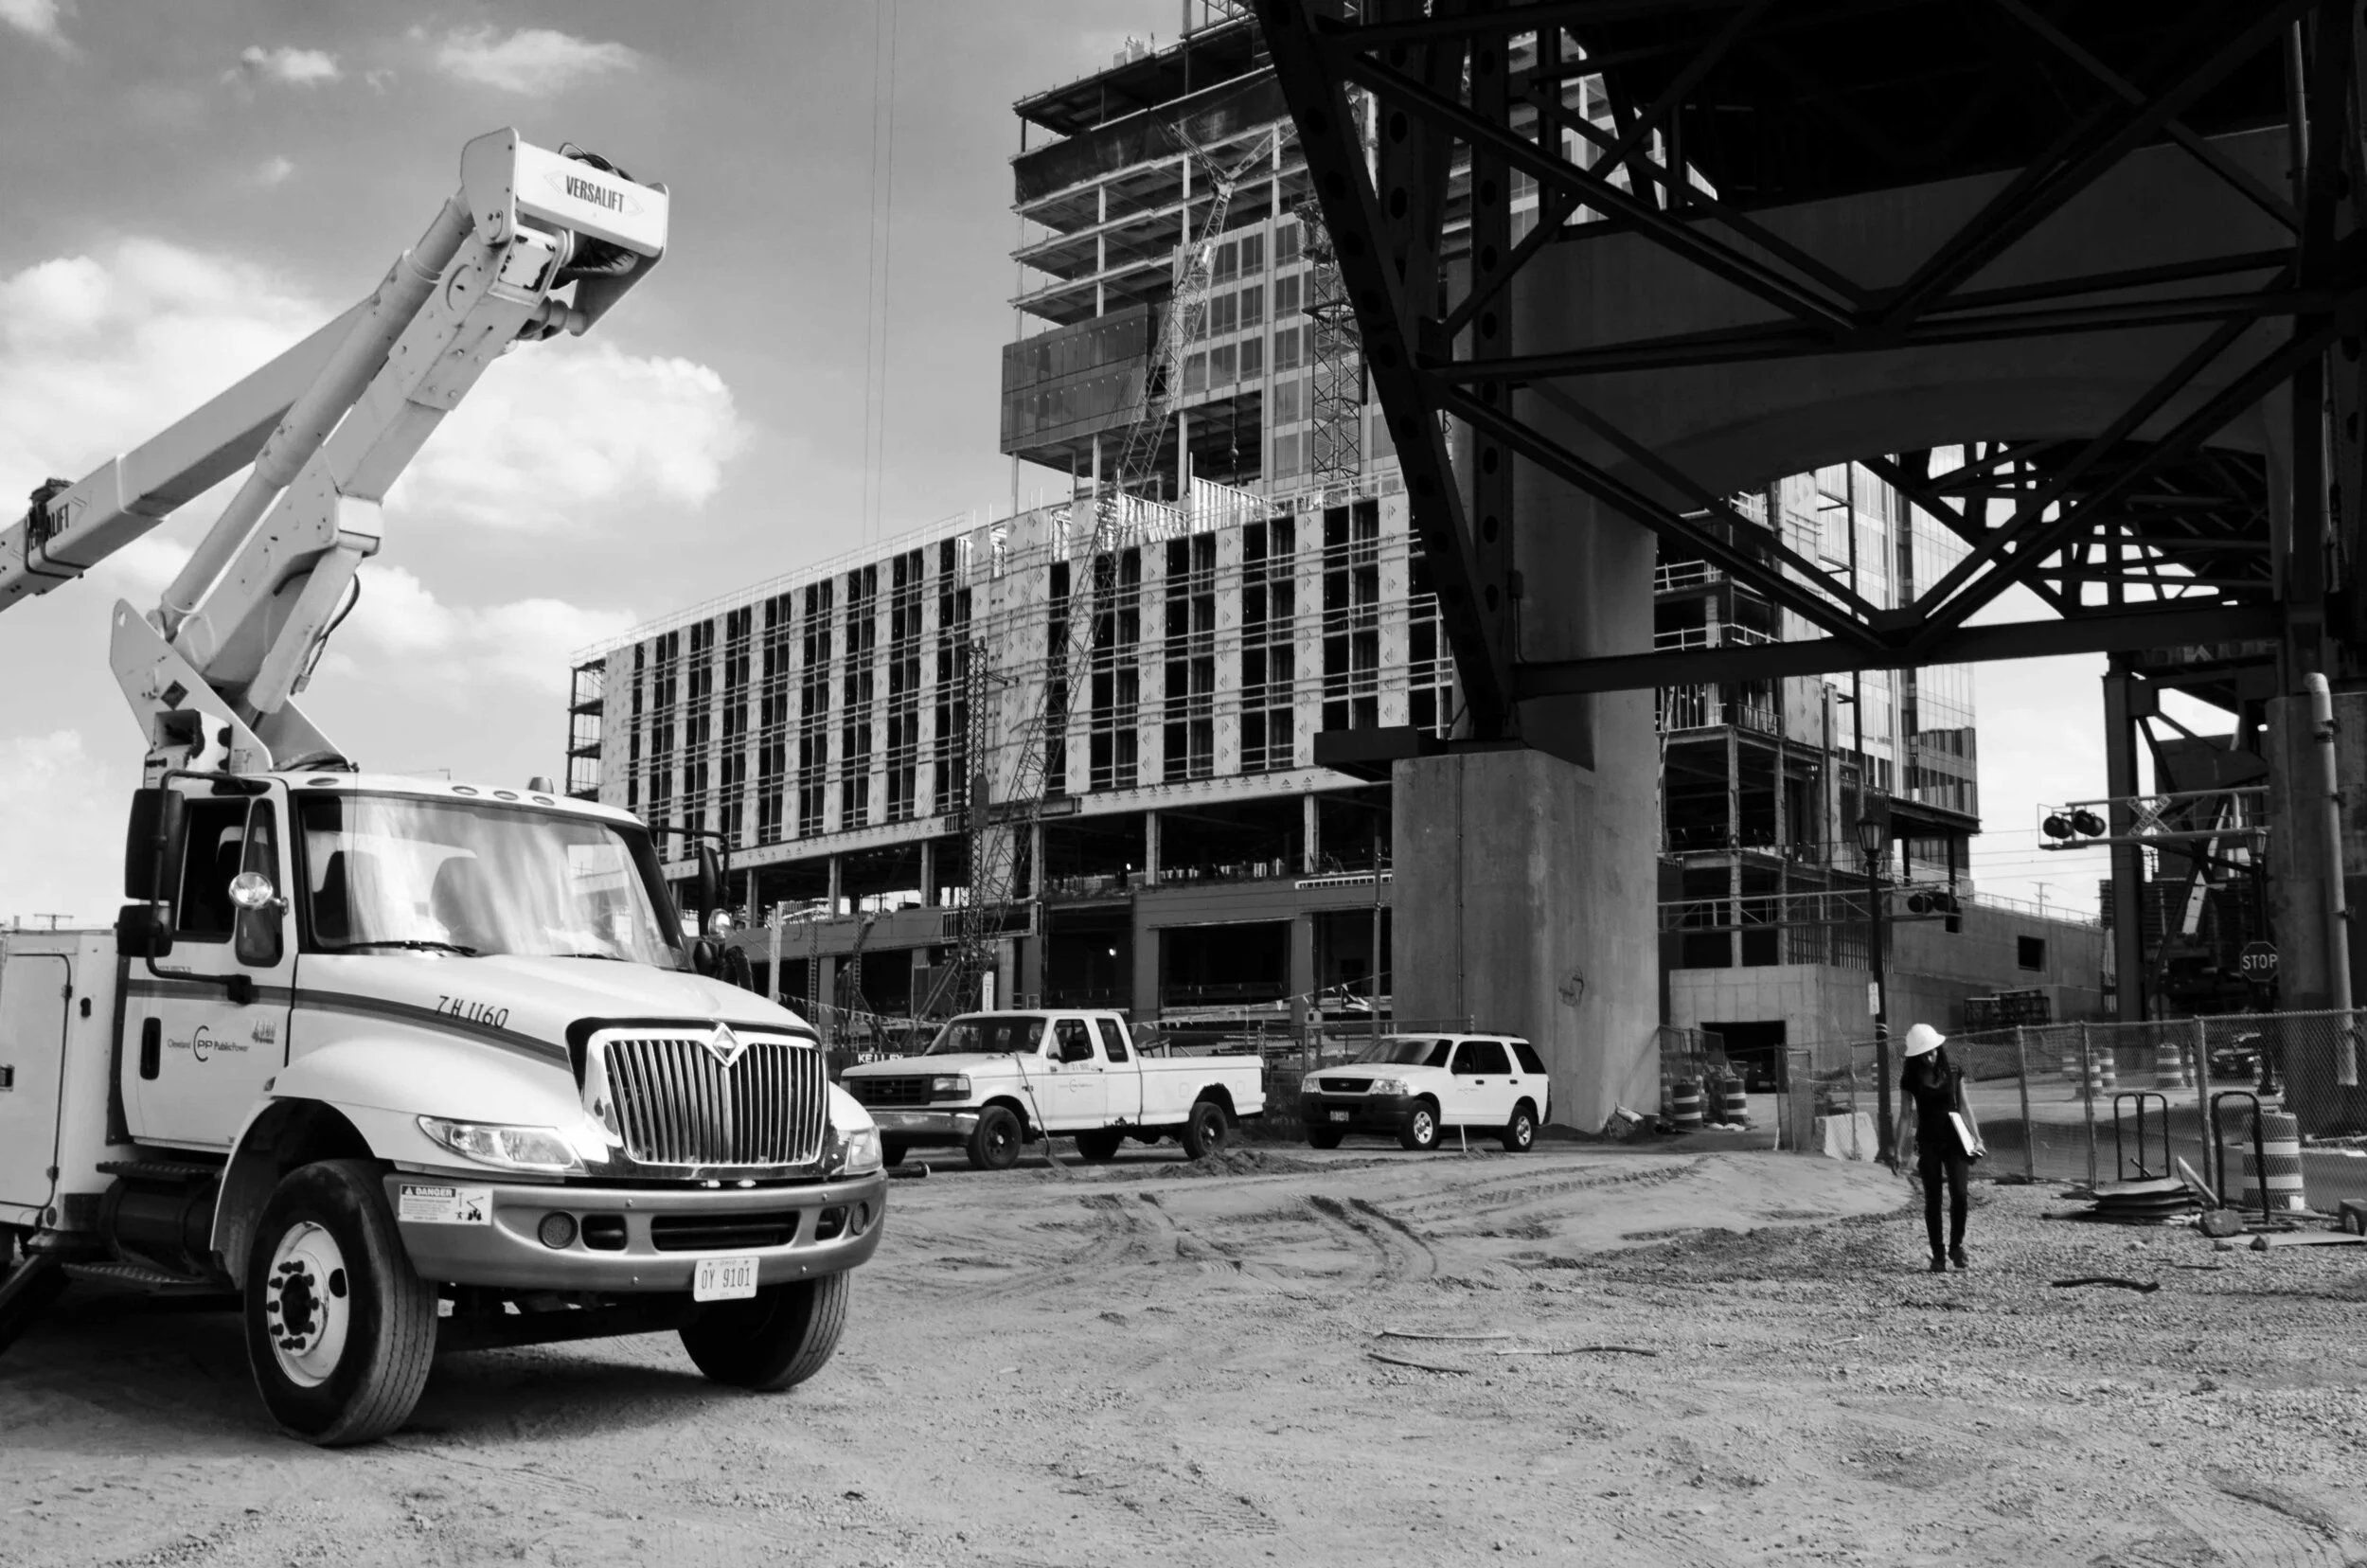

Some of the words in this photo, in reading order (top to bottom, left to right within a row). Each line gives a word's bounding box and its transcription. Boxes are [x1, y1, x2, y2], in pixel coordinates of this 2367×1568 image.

[566, 175, 624, 213] VERSALIFT
[2129, 797, 2169, 836] CROSSING
[2242, 953, 2278, 970] STOP
[416, 1186, 453, 1198] DANGER
[723, 1267, 750, 1288] 9101
